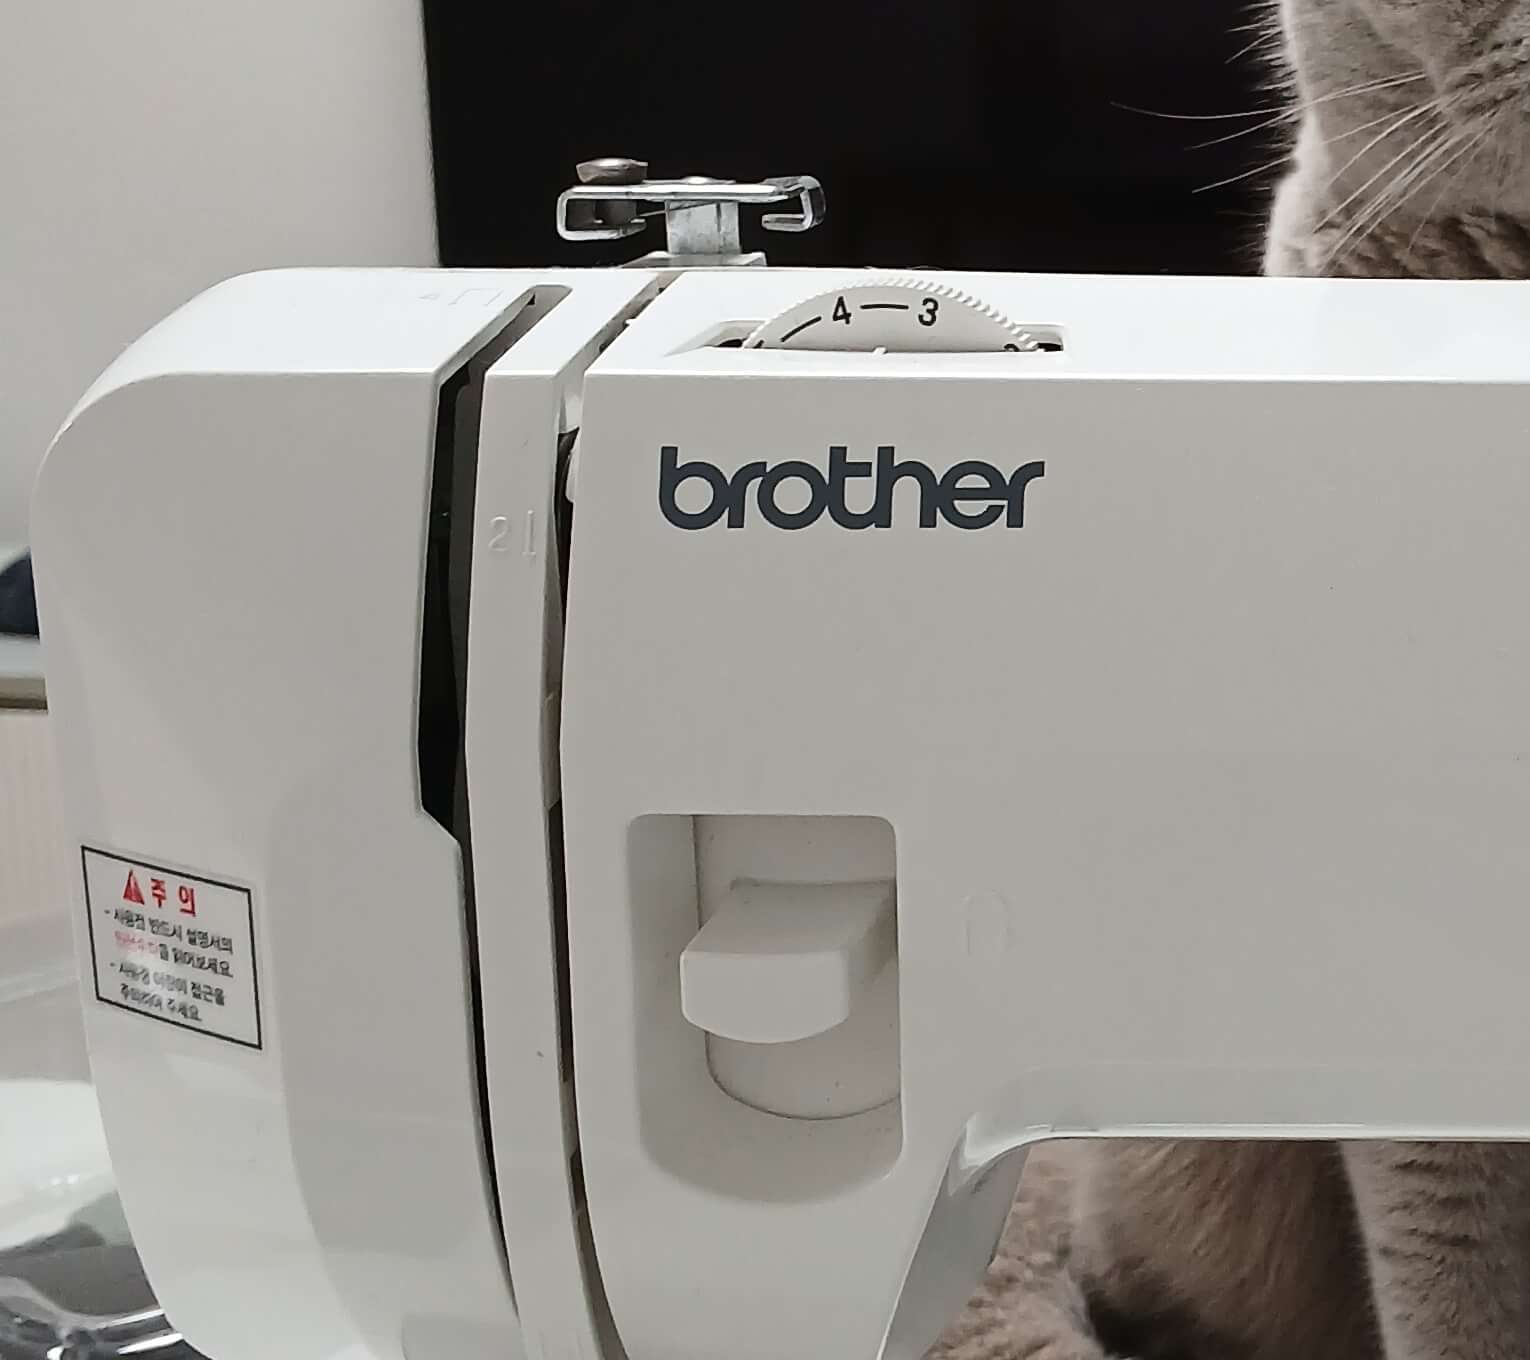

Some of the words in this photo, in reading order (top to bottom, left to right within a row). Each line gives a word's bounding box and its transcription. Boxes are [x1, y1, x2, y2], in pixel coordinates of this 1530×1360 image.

[833, 296, 851, 324] 4
[918, 298, 938, 326] 3
[659, 446, 1045, 530] brother
[150, 878, 167, 908] 주
[179, 886, 196, 917] 의
